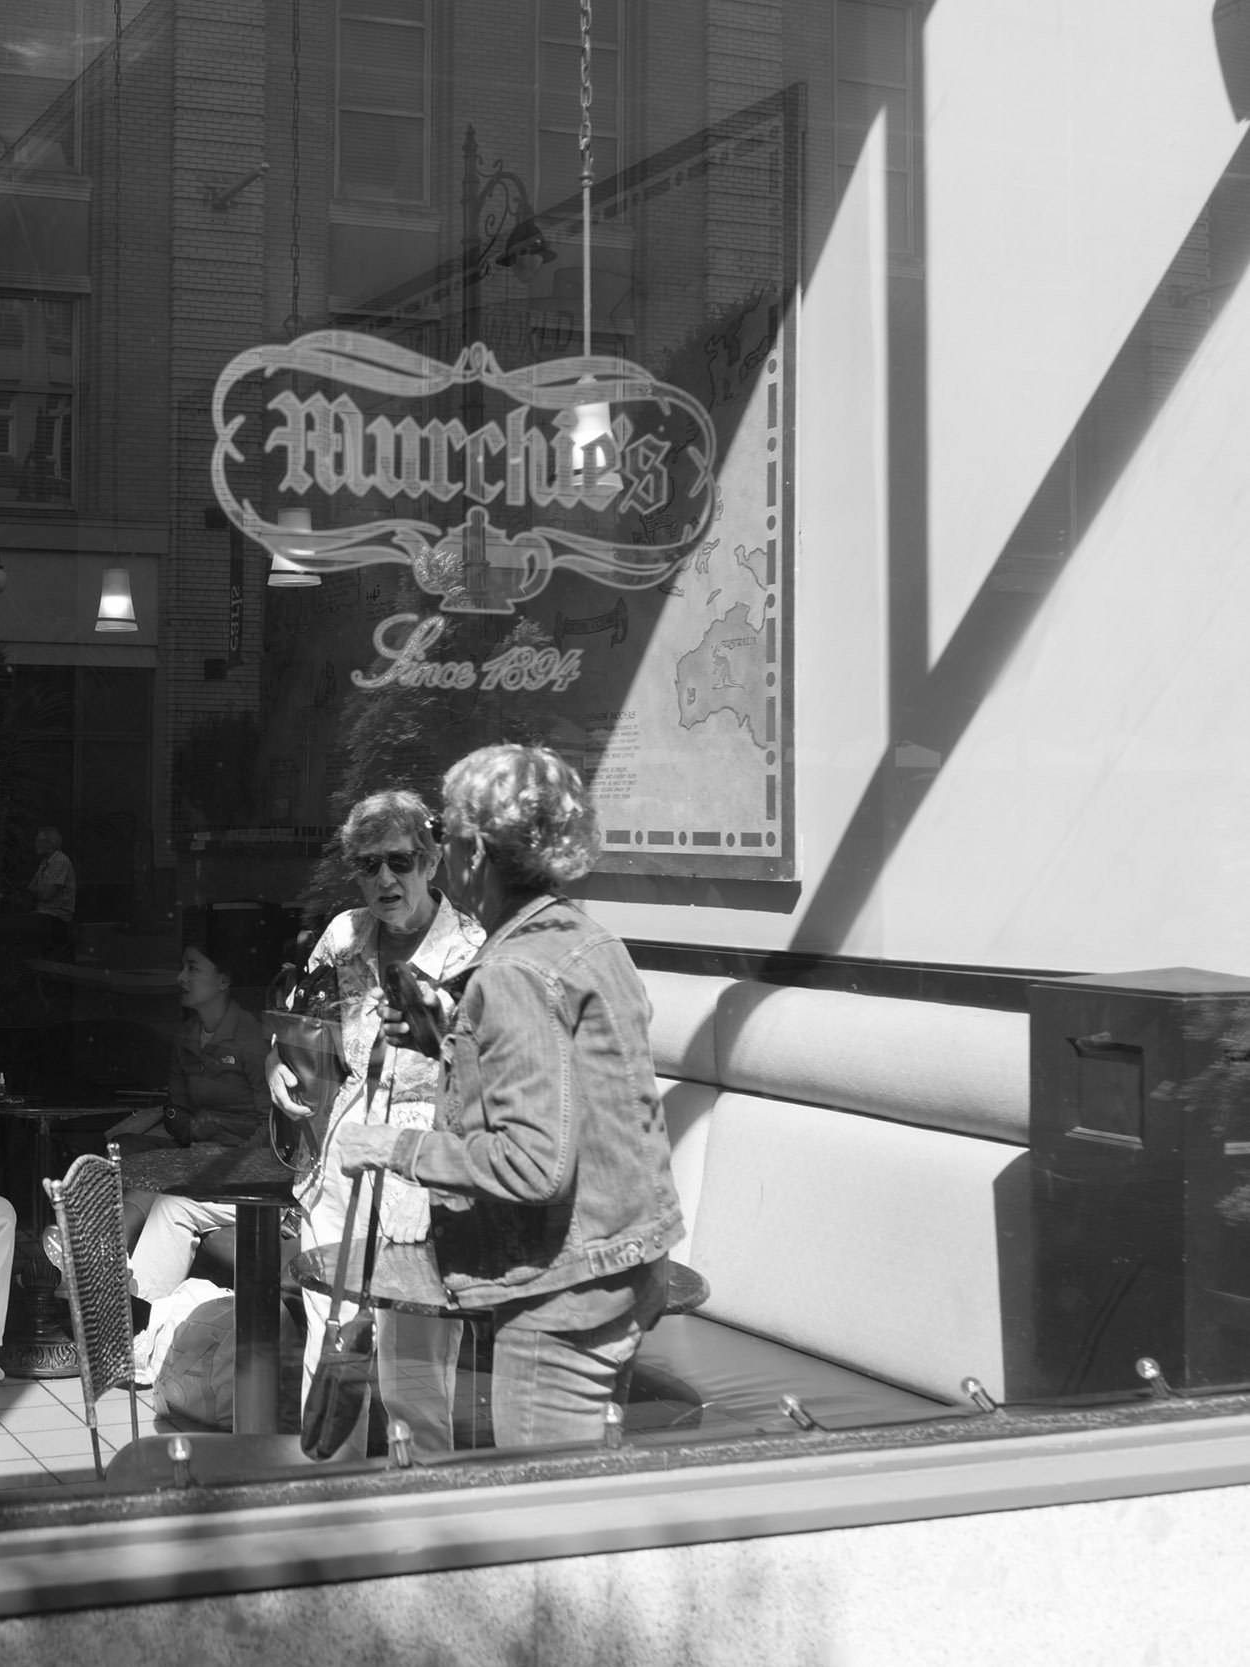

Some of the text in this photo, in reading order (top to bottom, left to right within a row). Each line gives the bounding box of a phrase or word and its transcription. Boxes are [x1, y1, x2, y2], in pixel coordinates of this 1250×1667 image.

[265, 390, 671, 514] Murchie's
[351, 612, 584, 691] Since 1894
